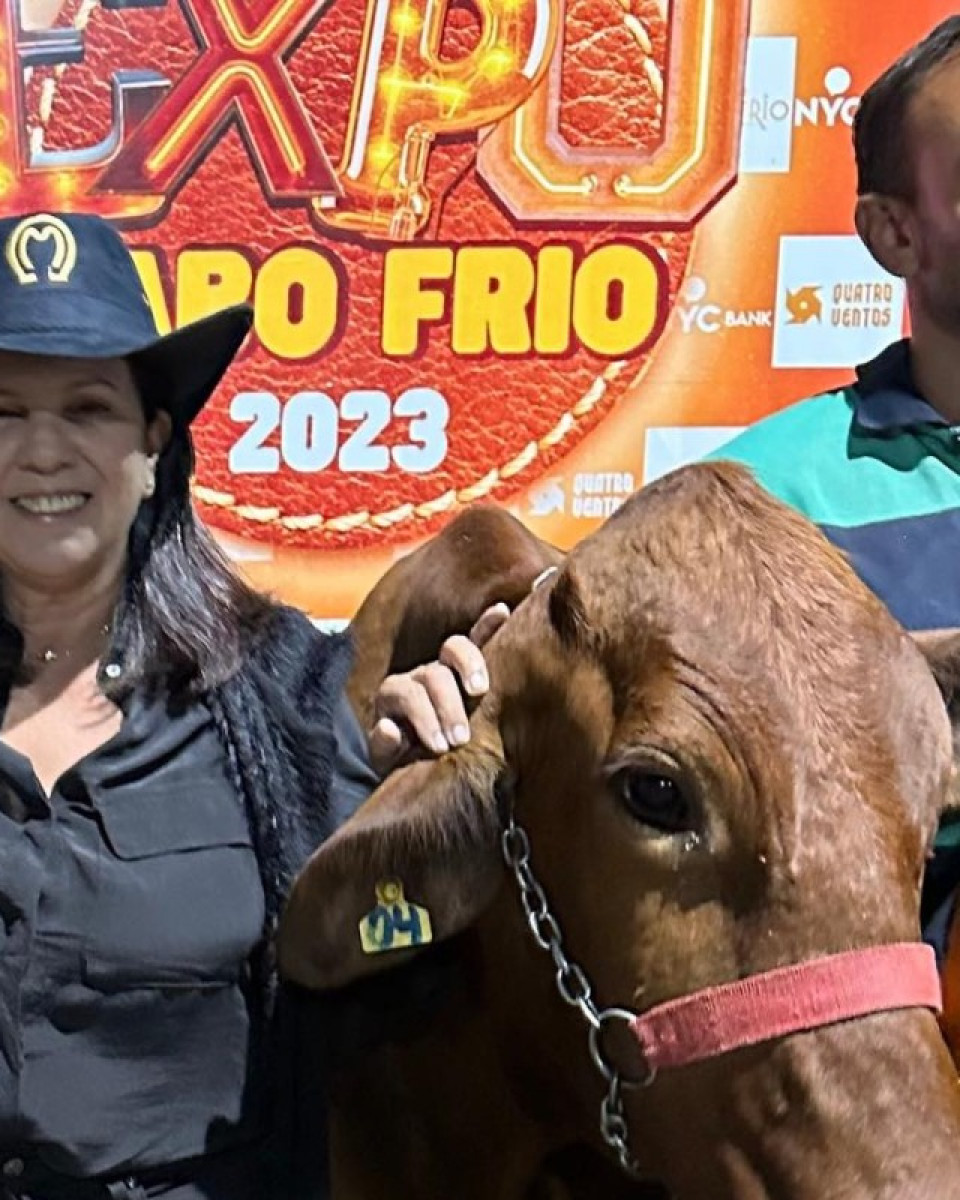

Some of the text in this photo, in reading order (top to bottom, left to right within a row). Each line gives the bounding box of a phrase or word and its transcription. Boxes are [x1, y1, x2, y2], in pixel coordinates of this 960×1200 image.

[381, 245, 658, 357] FRIO
[724, 310, 773, 328] BANK
[832, 283, 893, 304] QUATRO
[228, 387, 450, 474] 2023
